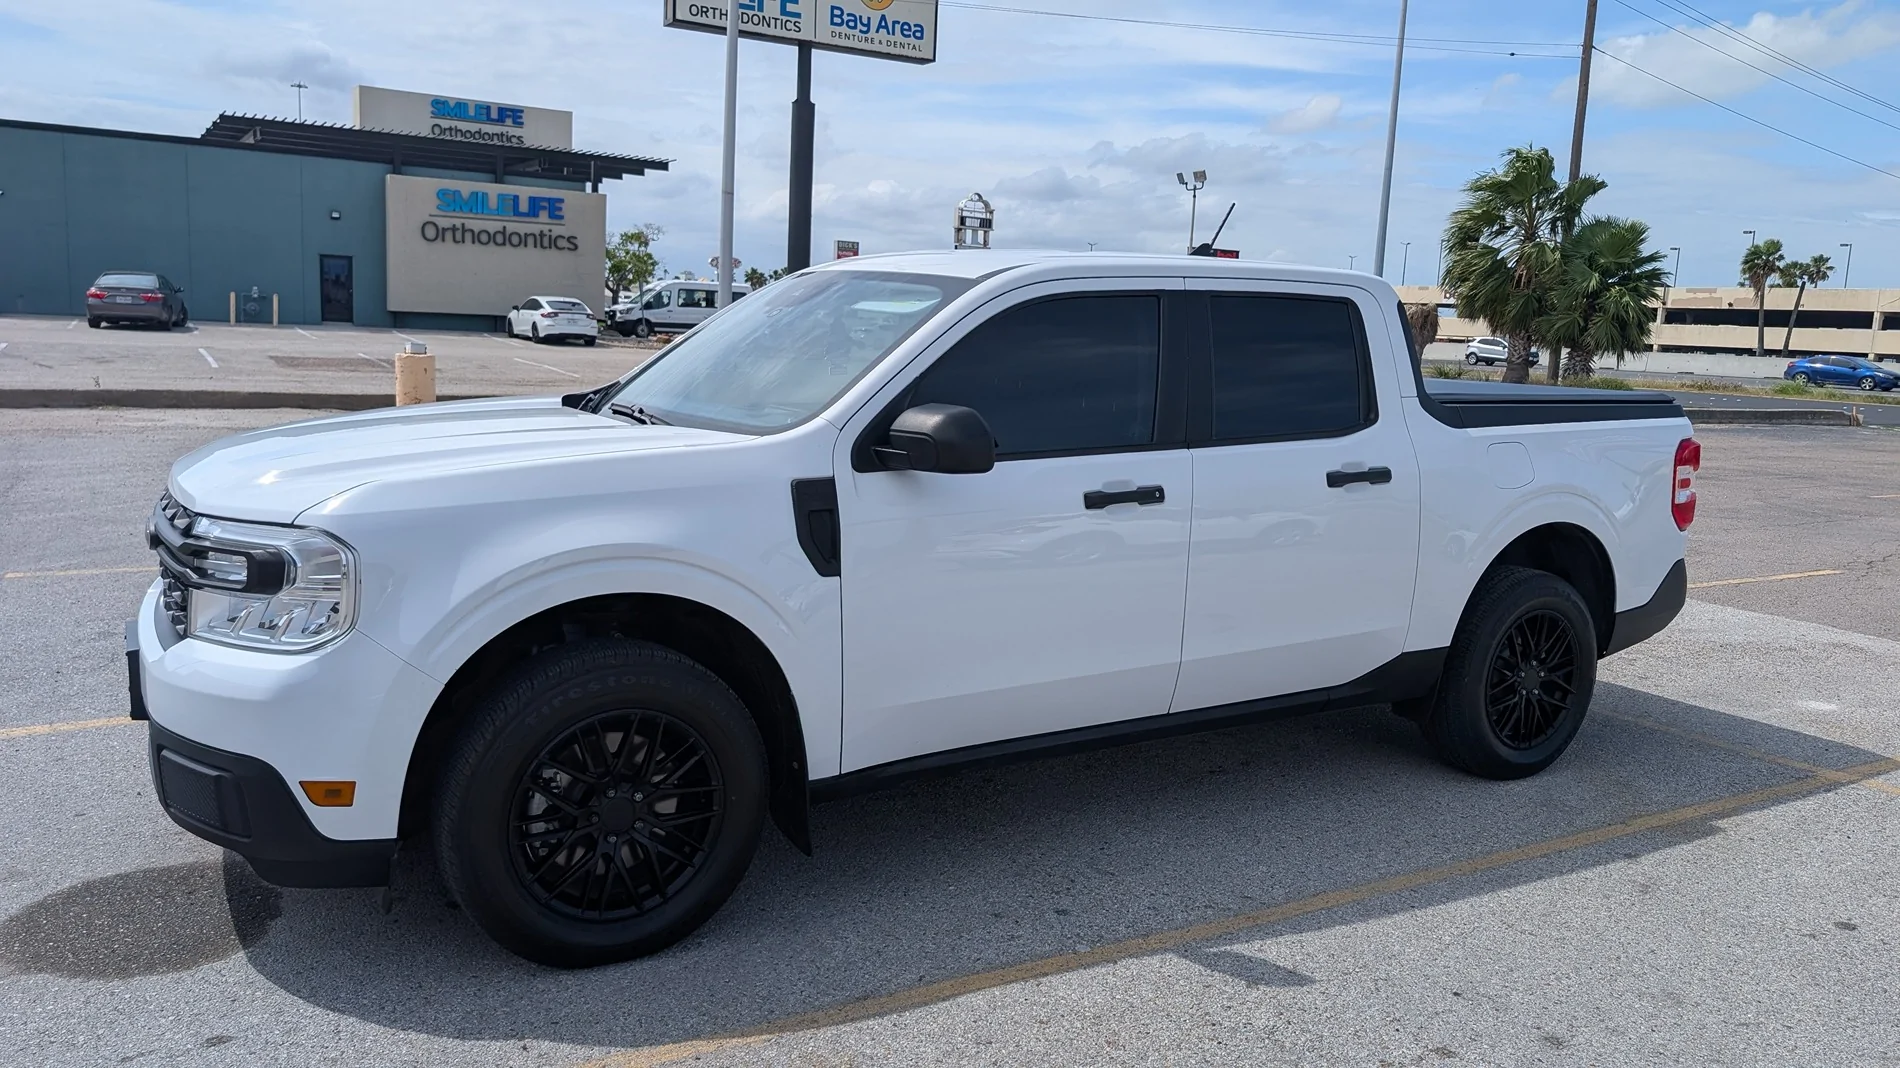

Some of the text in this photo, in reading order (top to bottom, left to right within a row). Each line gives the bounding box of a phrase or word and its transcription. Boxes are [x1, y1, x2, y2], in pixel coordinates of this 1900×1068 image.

[689, 4, 802, 33] ORTHDONTICS
[829, 5, 871, 35] Bay
[875, 14, 925, 41] Area
[830, 30, 876, 45] DENTURE
[886, 39, 923, 52] DENTAL
[431, 123, 525, 145] Orthodontics
[420, 220, 579, 252] Orthodontics
